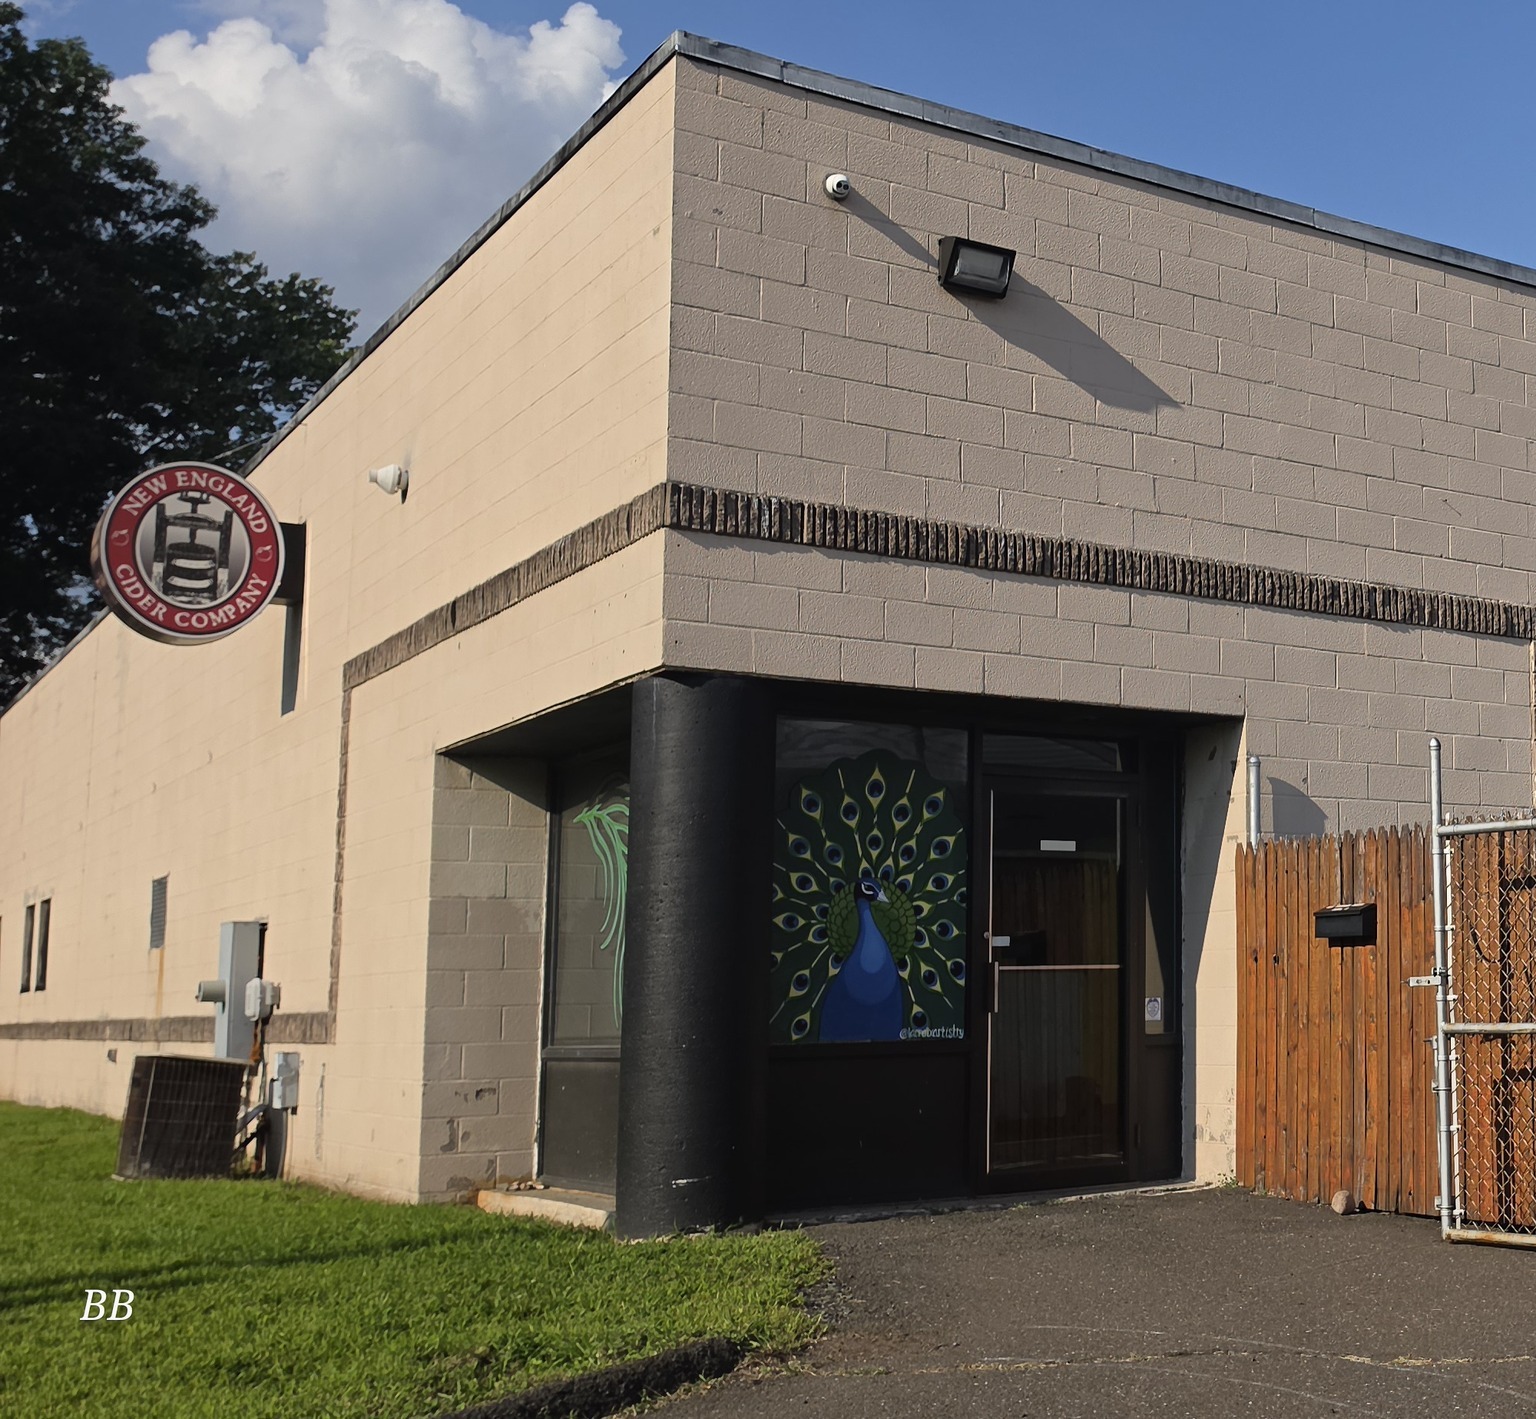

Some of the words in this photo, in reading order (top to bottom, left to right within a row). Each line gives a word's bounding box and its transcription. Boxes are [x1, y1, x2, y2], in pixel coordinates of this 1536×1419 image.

[121, 474, 168, 516] NEW
[175, 471, 268, 533] ENGLAND
[116, 563, 167, 621] CIDER
[174, 572, 268, 629] COMPANY
